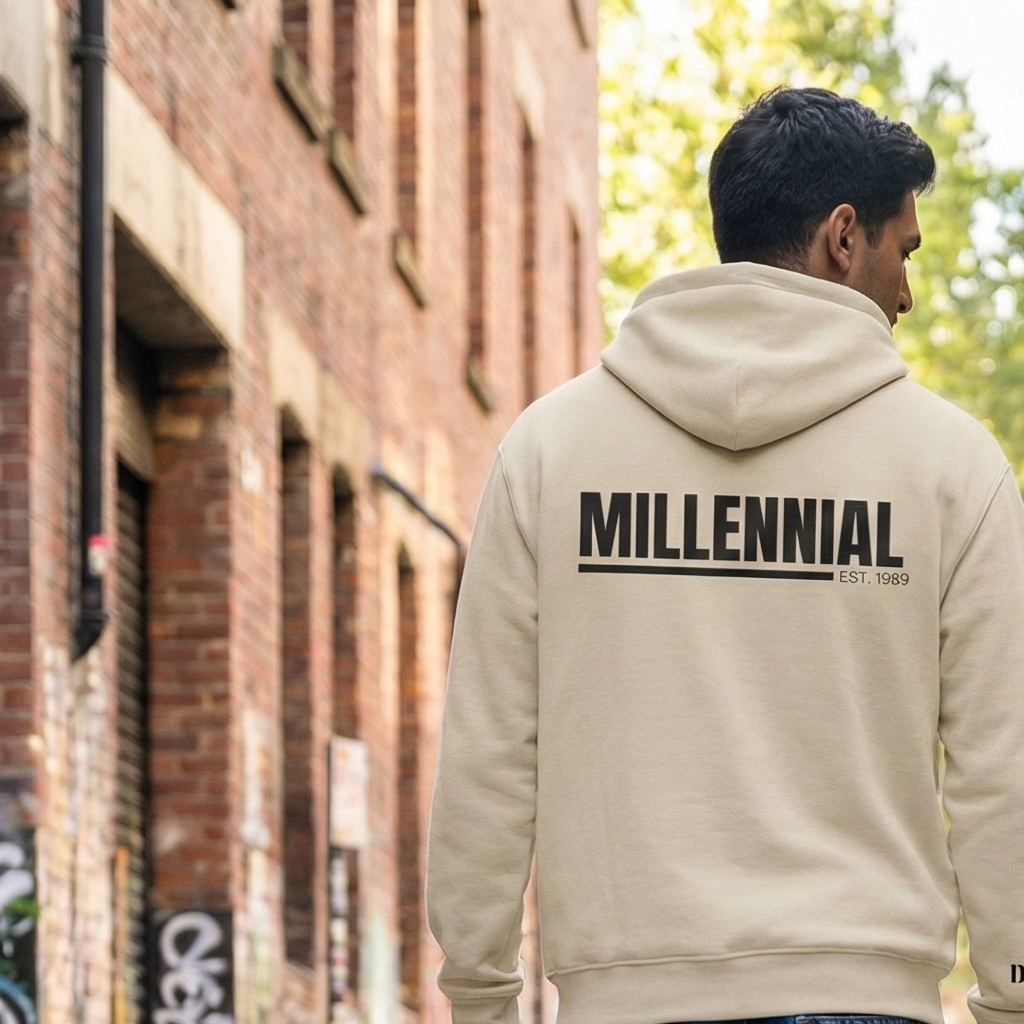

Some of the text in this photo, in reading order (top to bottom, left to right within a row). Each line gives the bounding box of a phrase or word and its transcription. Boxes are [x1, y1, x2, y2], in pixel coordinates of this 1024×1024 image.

[579, 491, 904, 568] MILLENNIAL
[839, 570, 910, 586] EST. 1989
